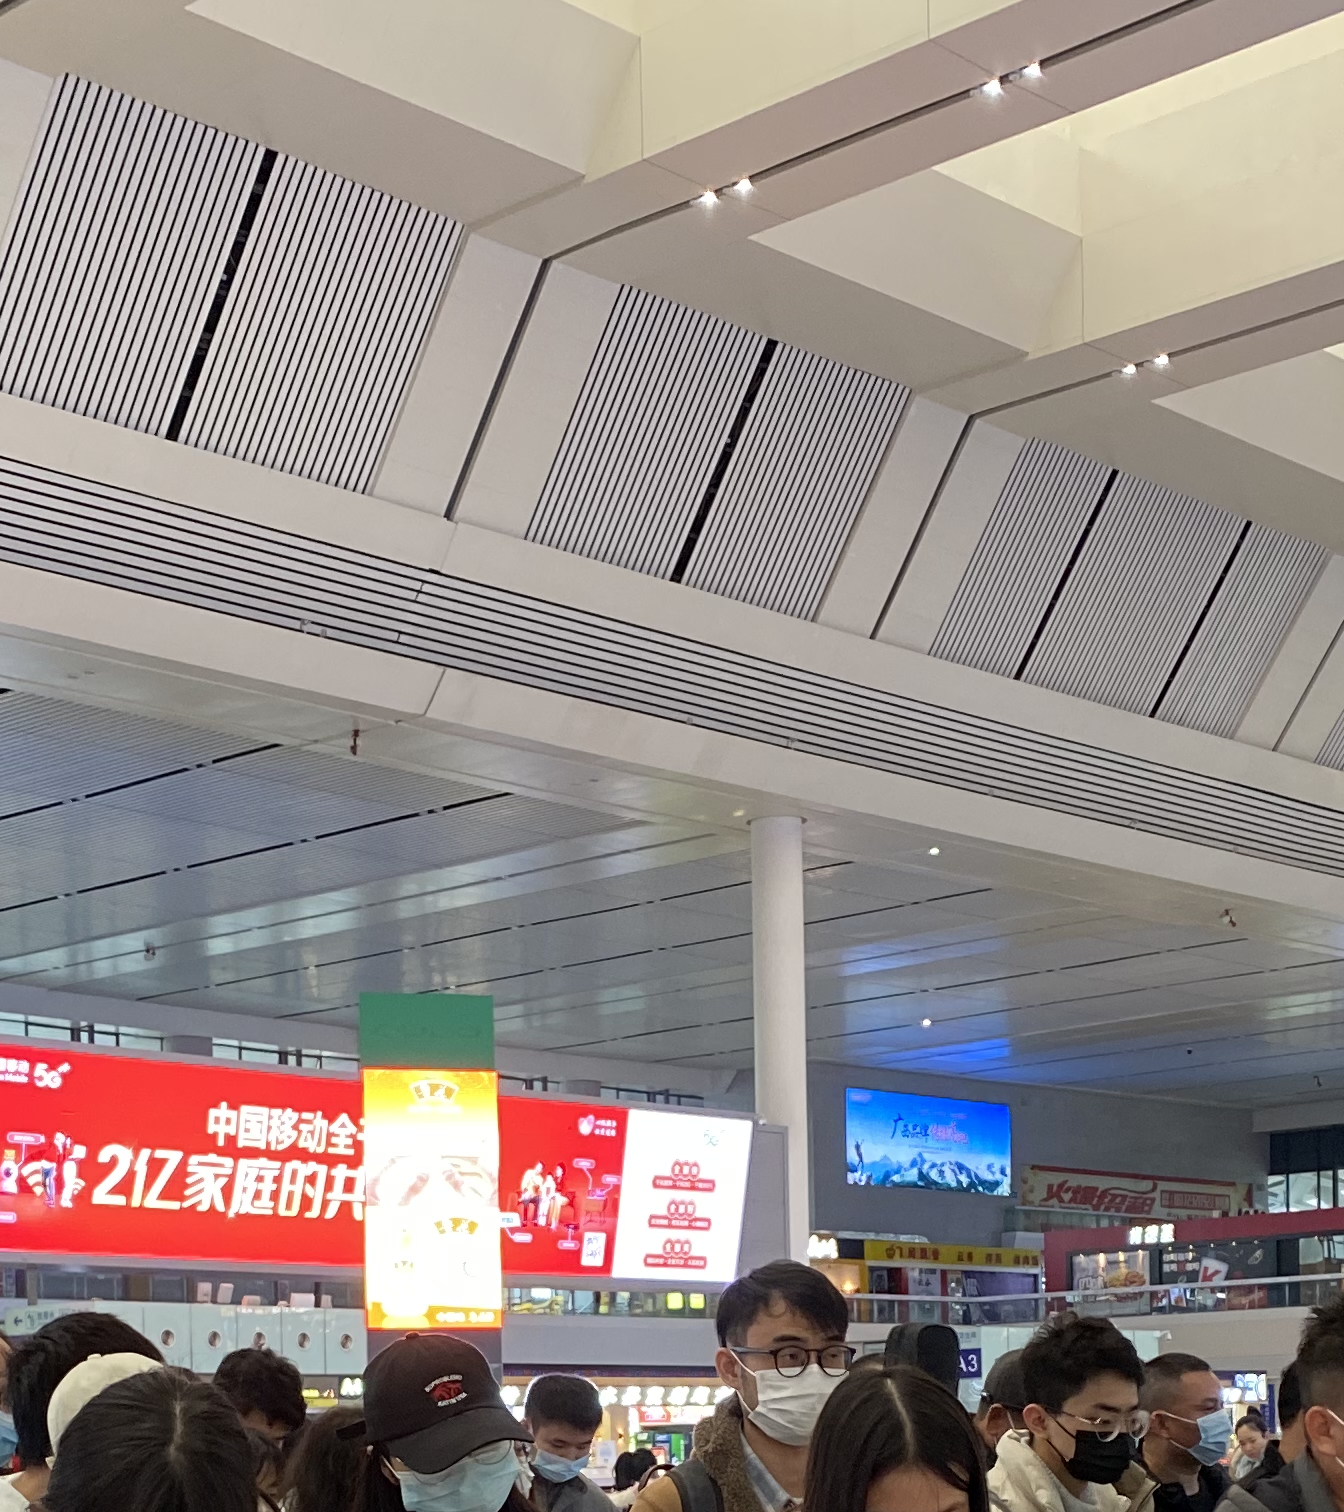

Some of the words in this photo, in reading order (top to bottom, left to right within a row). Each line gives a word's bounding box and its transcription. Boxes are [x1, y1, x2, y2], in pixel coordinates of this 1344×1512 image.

[34, 1062, 62, 1089] 5G
[207, 1101, 365, 1155] 中国移动全
